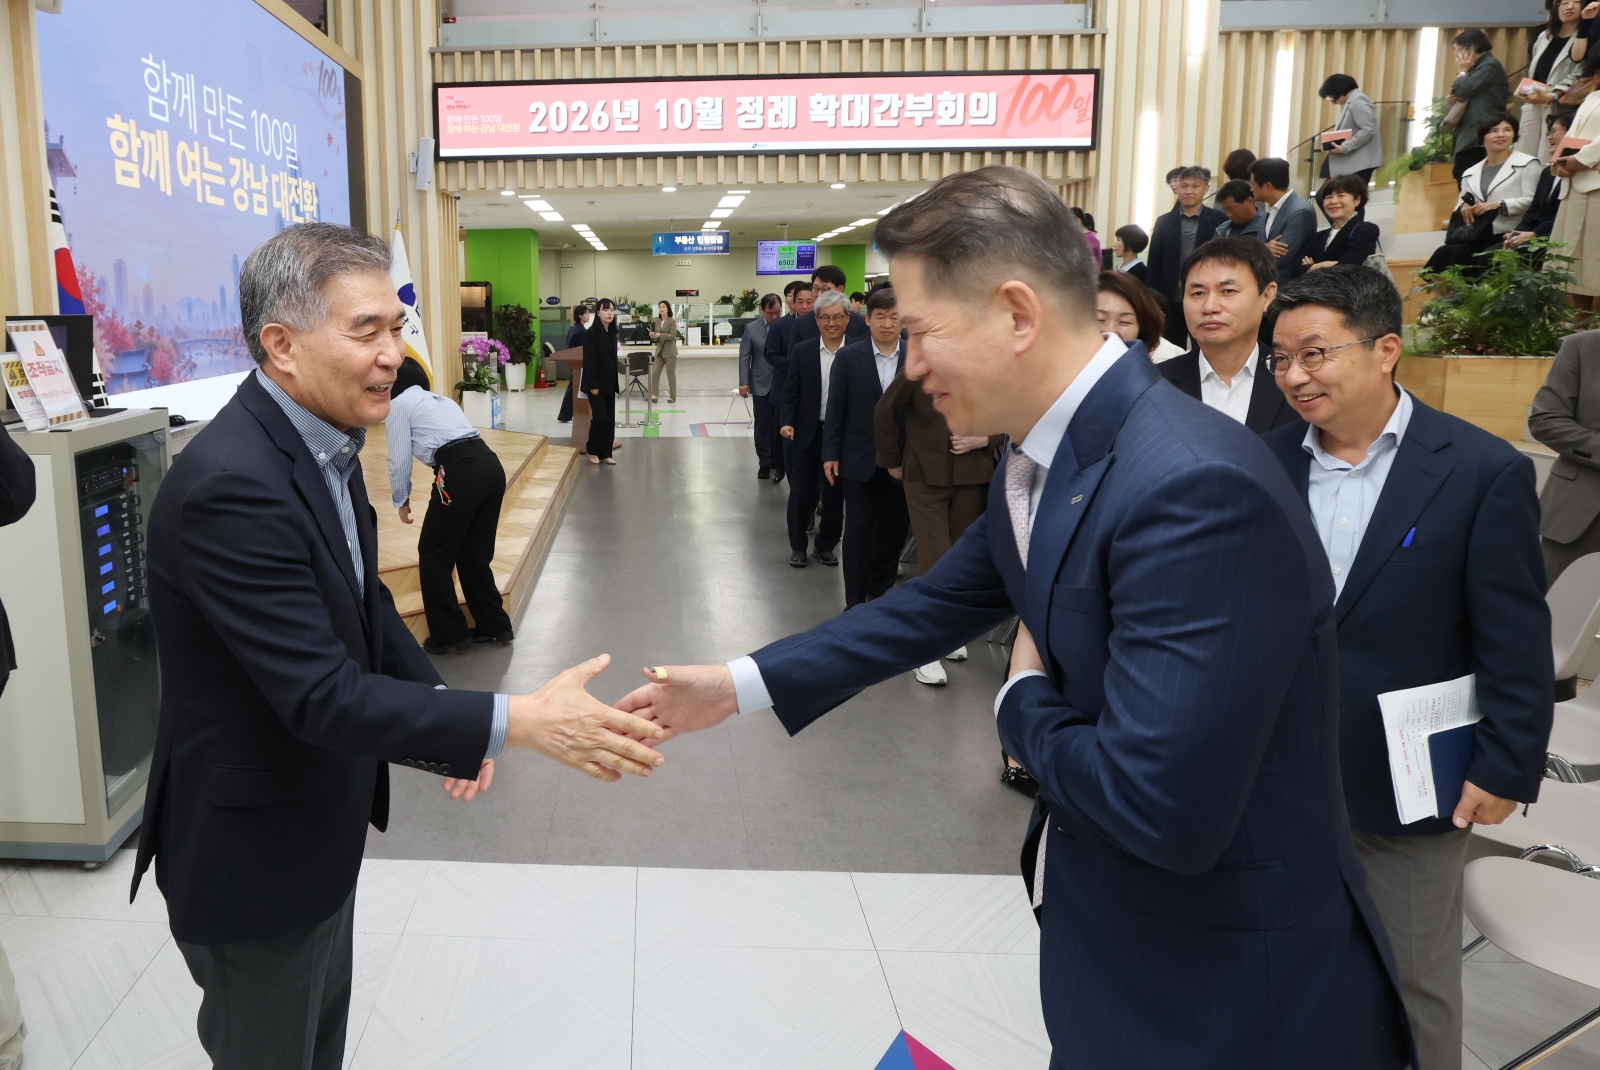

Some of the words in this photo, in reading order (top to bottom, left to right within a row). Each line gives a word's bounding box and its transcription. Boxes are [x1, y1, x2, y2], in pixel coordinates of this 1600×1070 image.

[141, 52, 198, 135] 함께
[203, 84, 247, 151] 만든
[250, 108, 299, 171] 100일
[446, 115, 462, 125] 함께
[463, 114, 479, 124] 만든
[480, 113, 502, 123] 100일
[528, 98, 641, 134] 2026년
[654, 96, 724, 131] 10월
[736, 95, 798, 130] 정례
[808, 91, 998, 129] 확대간부회의
[1002, 74, 1092, 134] 100일
[446, 124, 463, 134] 함께
[463, 124, 479, 133] 여는
[480, 123, 496, 133] 강남
[497, 122, 521, 133] 대전환
[106, 112, 173, 197] 함께
[176, 140, 227, 206] 여는
[229, 156, 269, 217] 강남
[271, 170, 318, 225] 대전환
[26, 359, 64, 379] 조작금지
